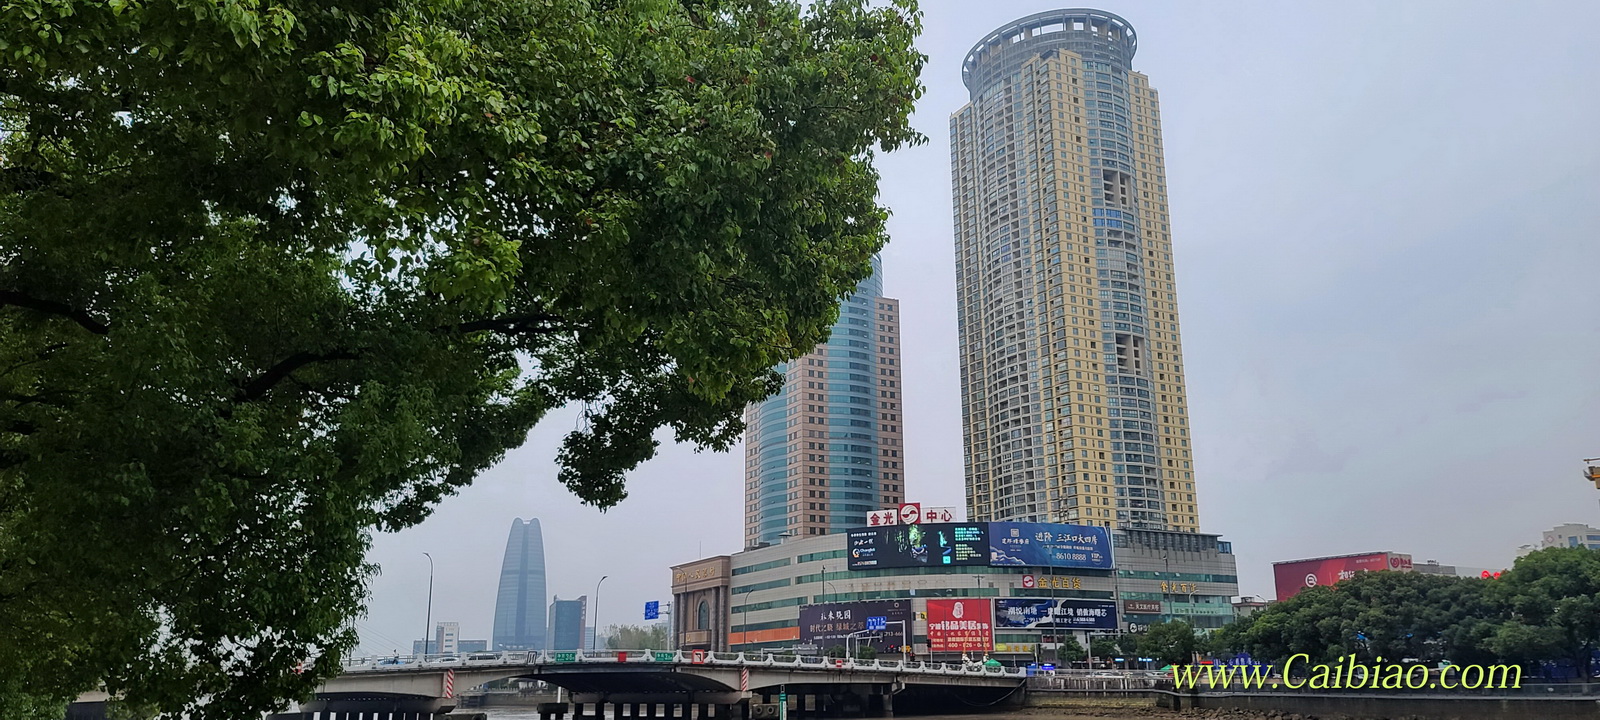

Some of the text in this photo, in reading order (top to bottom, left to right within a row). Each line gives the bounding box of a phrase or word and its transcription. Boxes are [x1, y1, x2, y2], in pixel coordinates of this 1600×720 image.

[870, 509, 953, 526] 金光 中心
[1037, 576, 1082, 590] 金光百货
